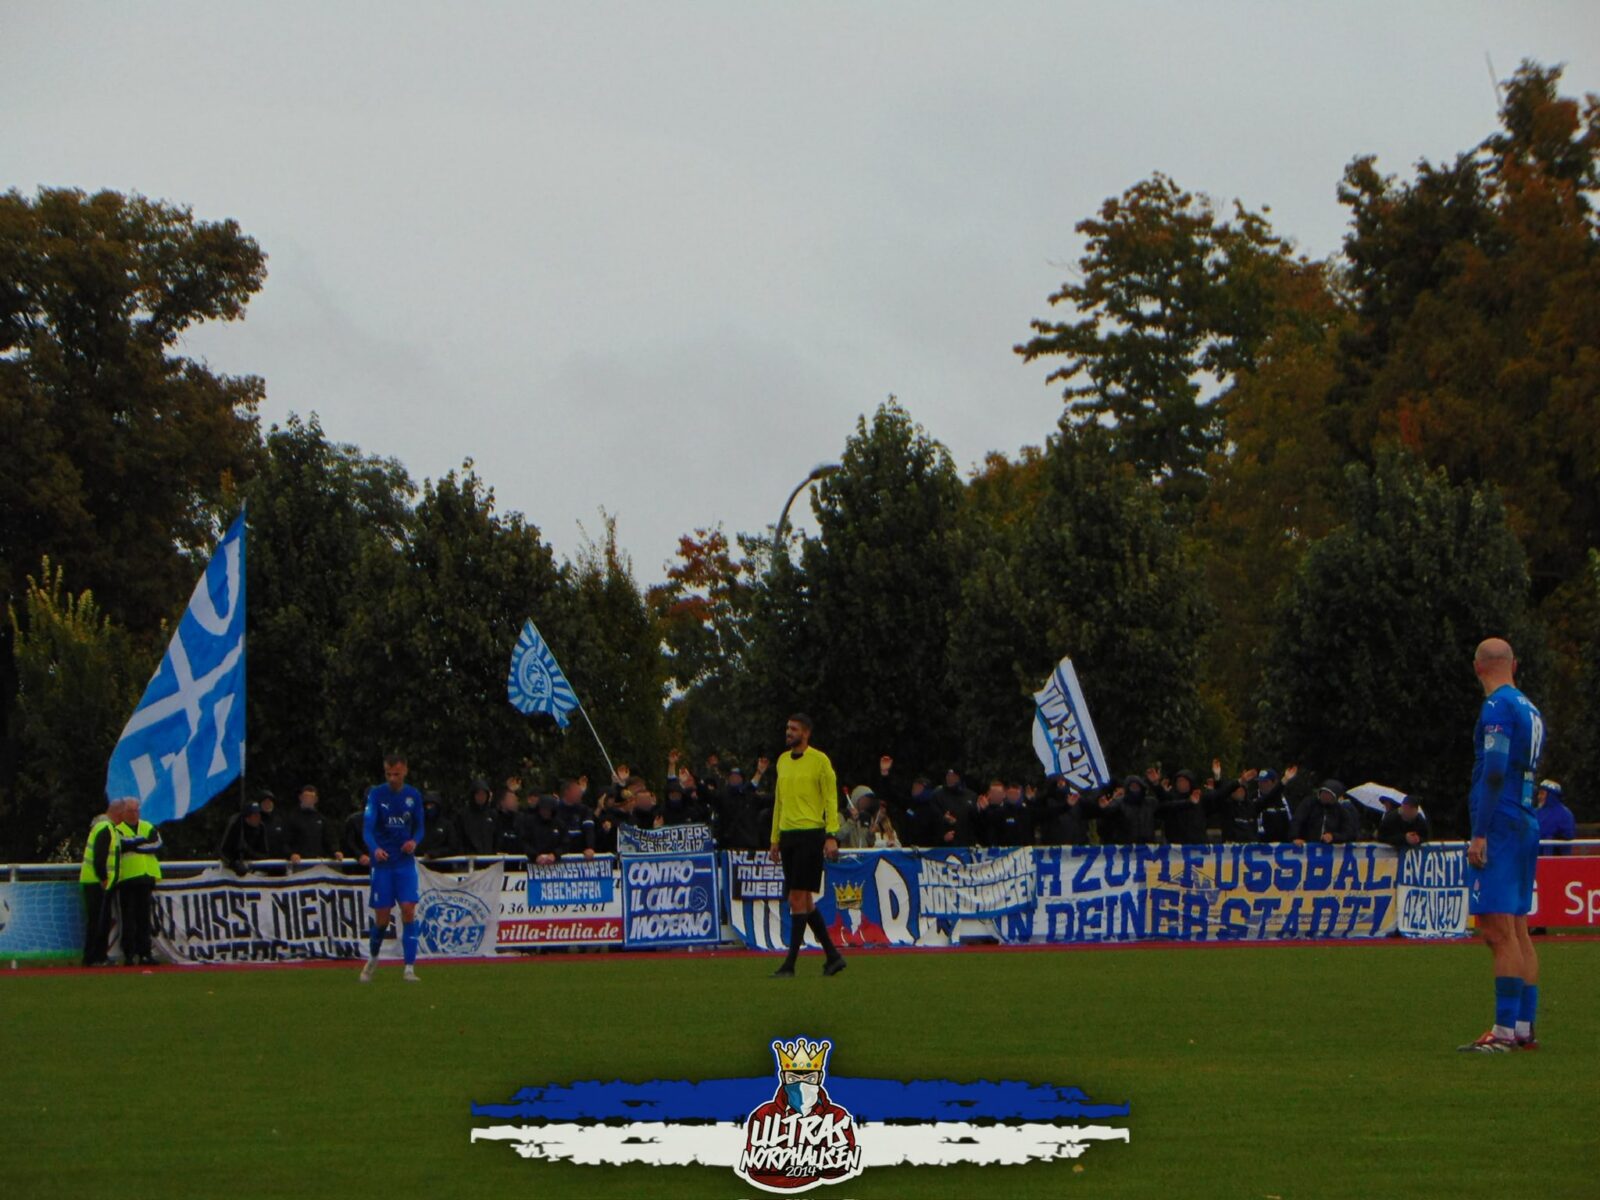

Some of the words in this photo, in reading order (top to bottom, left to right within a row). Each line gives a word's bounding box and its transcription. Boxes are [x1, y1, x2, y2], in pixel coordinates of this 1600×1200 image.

[628, 860, 693, 885] CONTRO
[737, 866, 785, 880] MUSS
[1072, 843, 1172, 893] ZUM
[1180, 842, 1402, 892] FUSSBAL
[631, 889, 647, 912] IL
[741, 881, 783, 897] WEG!
[920, 873, 1037, 914] NORDHAUSEN
[183, 890, 263, 942] WIRST
[508, 903, 524, 915] 36
[1046, 888, 1209, 943] DEINER
[630, 912, 713, 940] MODERNO
